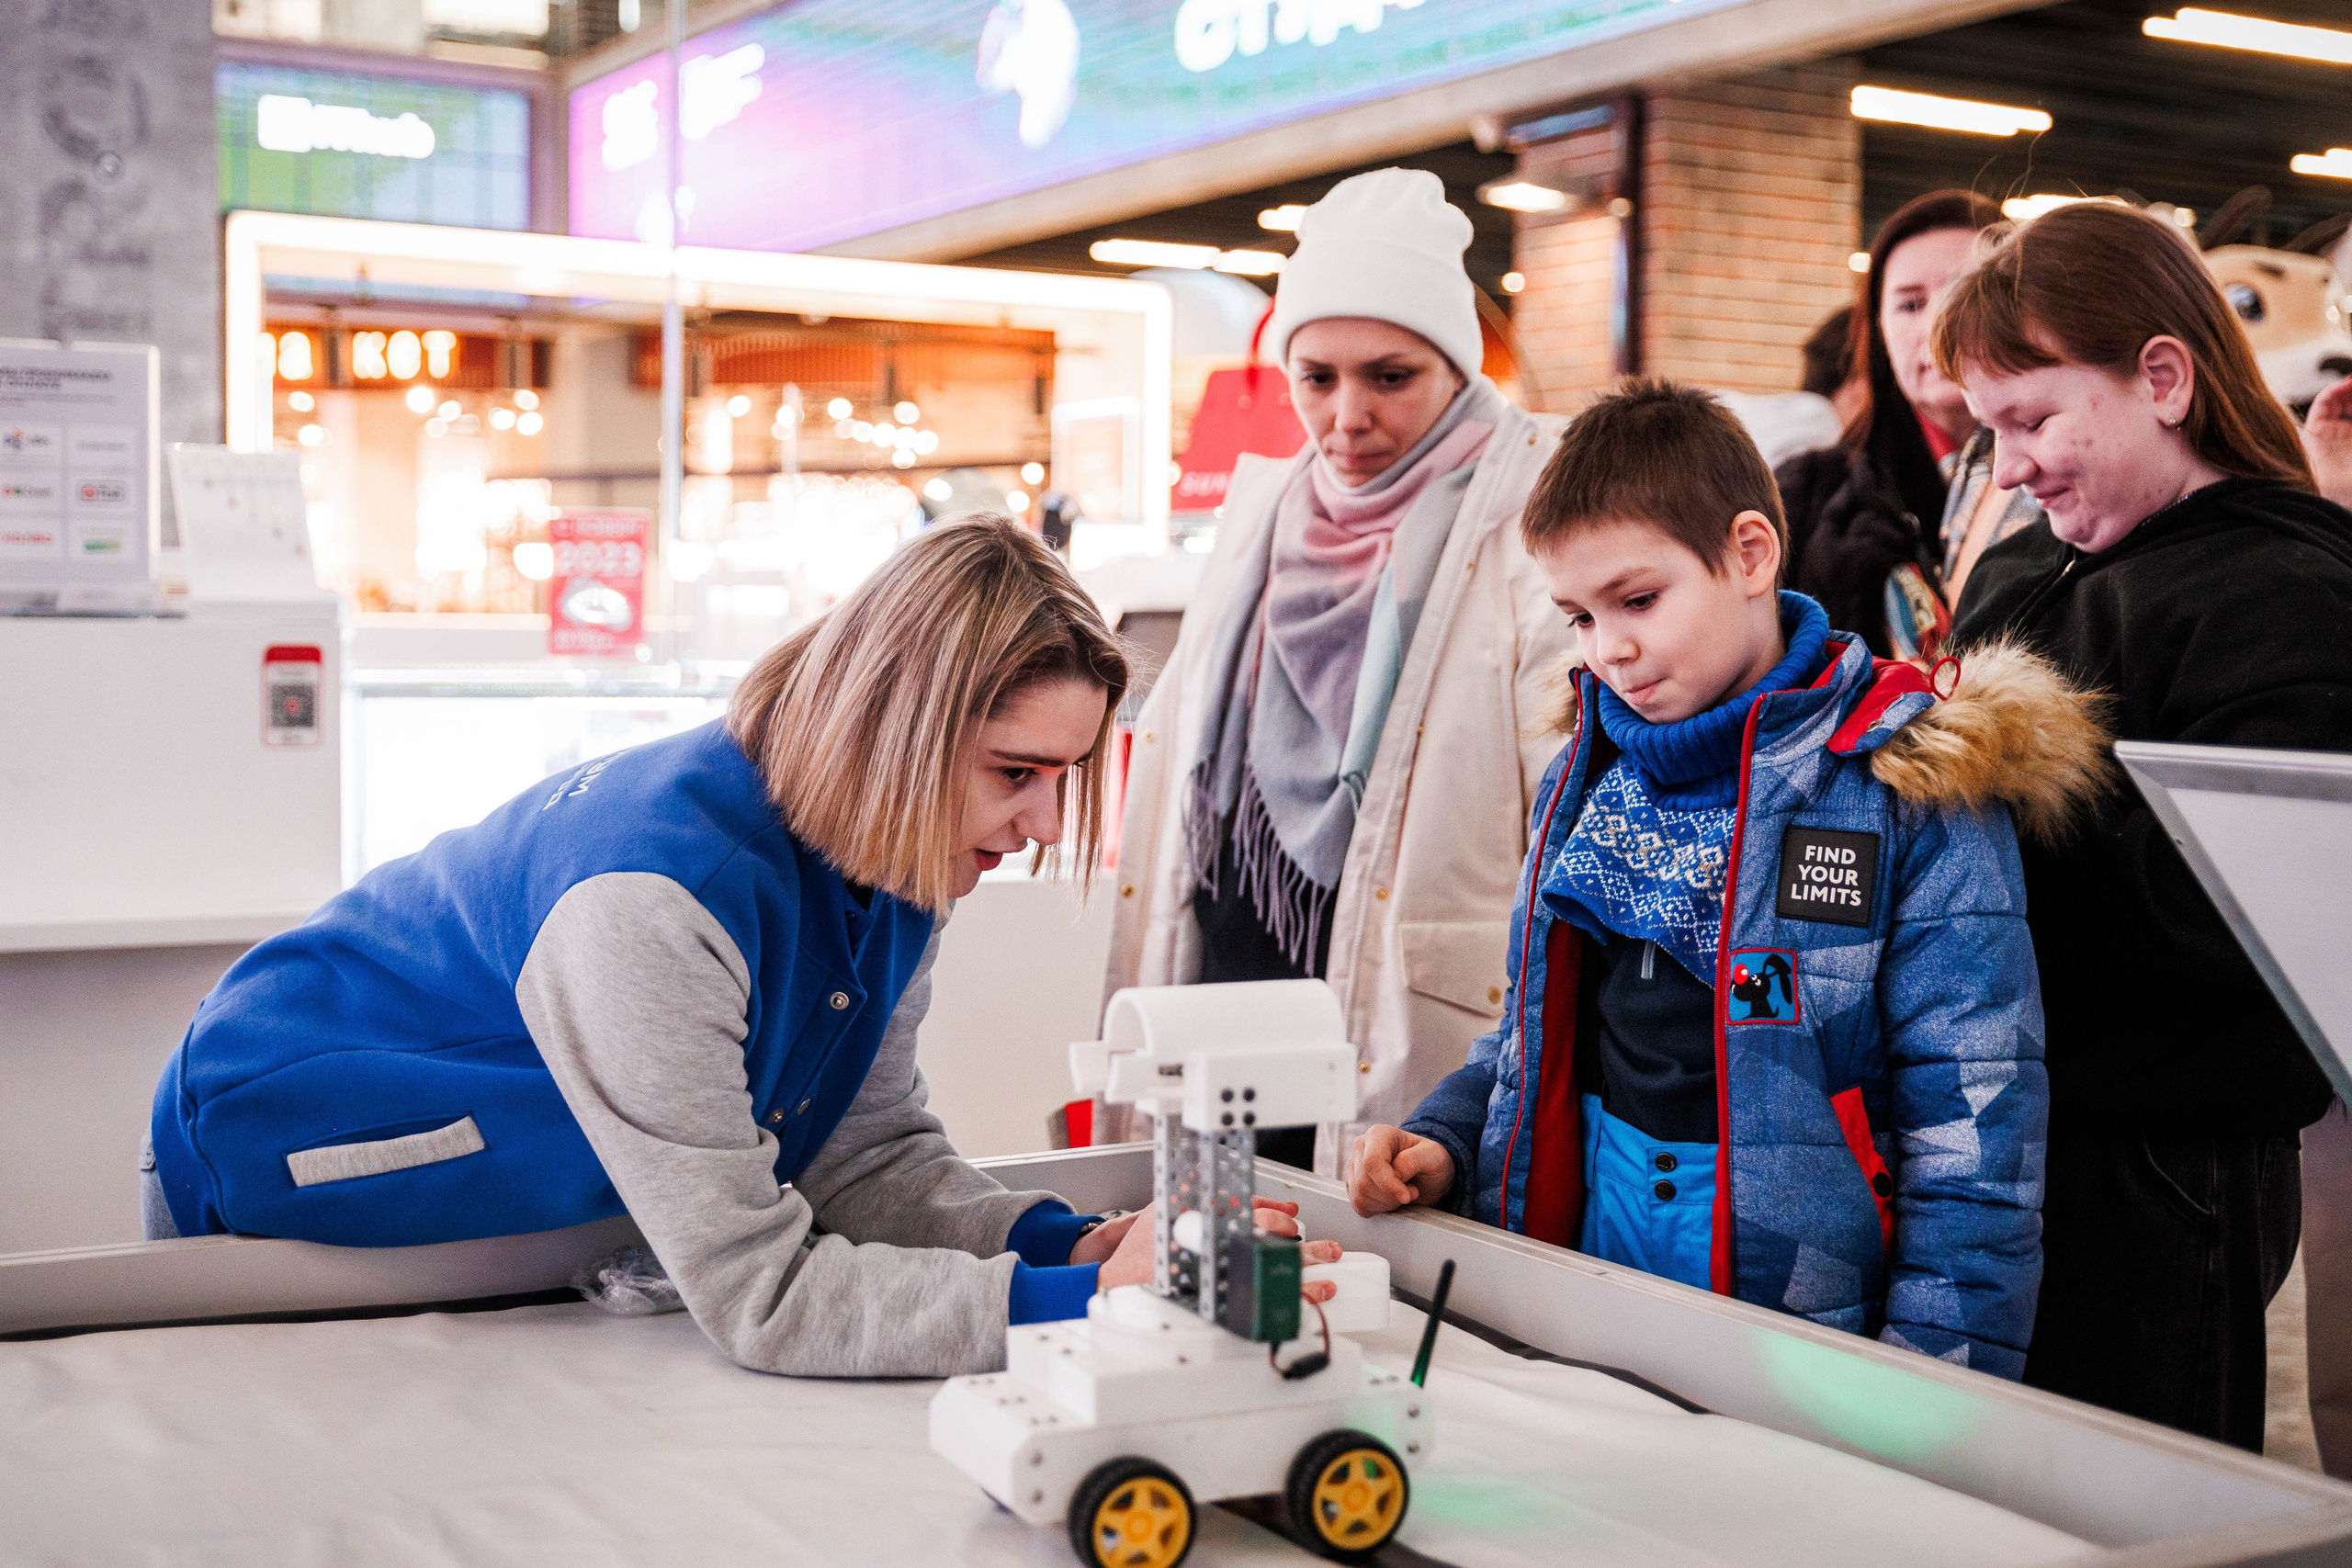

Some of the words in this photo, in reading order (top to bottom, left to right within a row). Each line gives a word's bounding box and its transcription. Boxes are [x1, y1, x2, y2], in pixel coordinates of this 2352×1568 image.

[1804, 845, 1857, 865] FIND
[1798, 864, 1859, 886] YOUR
[1791, 884, 1861, 907] LIMITS
